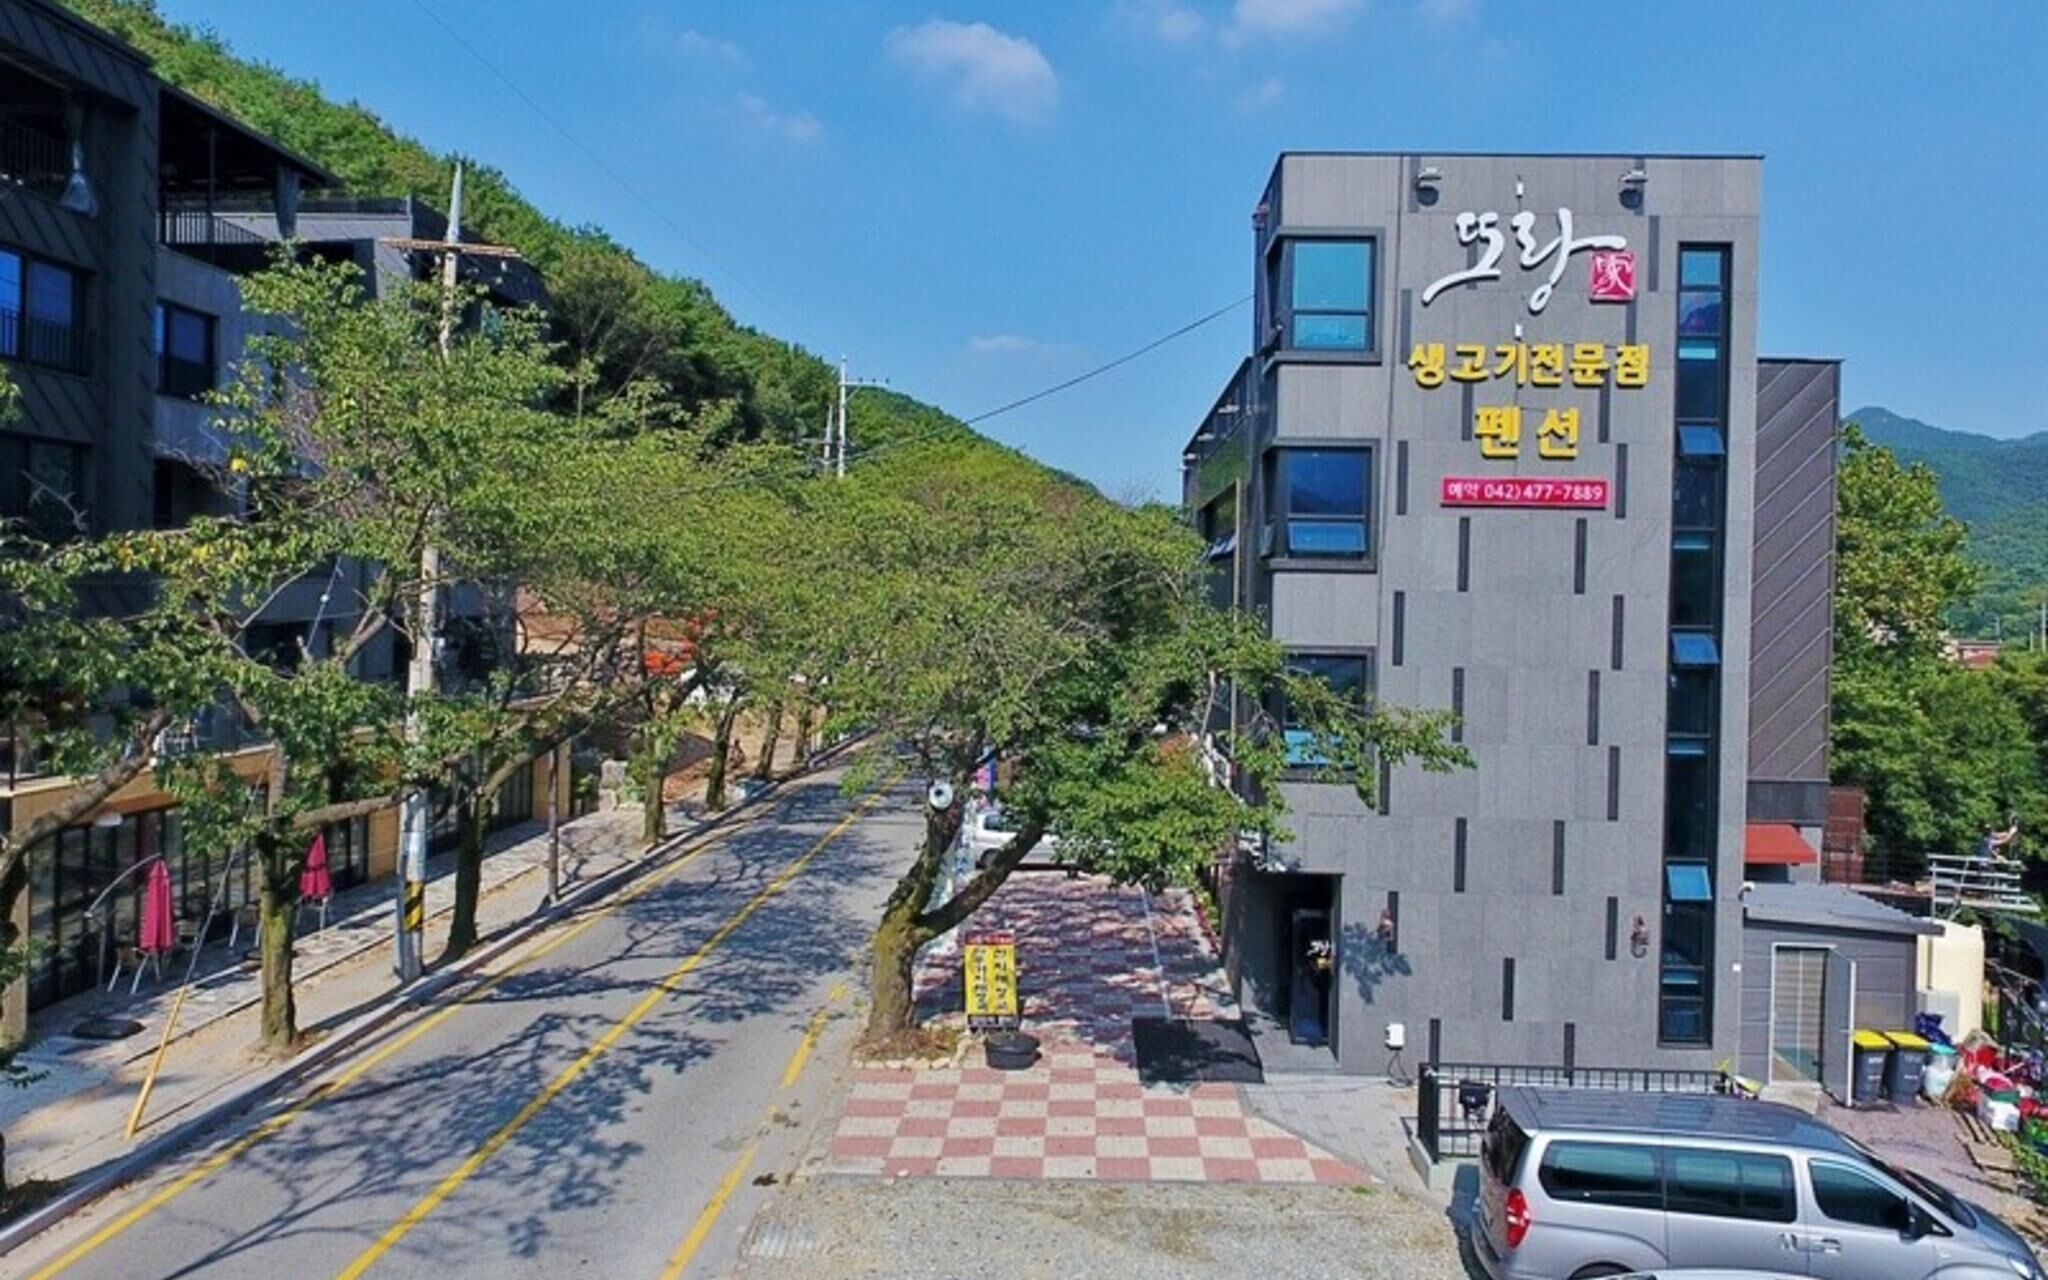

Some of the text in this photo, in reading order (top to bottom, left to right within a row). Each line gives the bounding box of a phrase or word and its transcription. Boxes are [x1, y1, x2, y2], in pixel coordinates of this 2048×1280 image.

[1422, 207, 1627, 312] 또랑
[1408, 343, 1648, 386] 생고기전문점
[1448, 481, 1603, 500] 예약 042)477-7889
